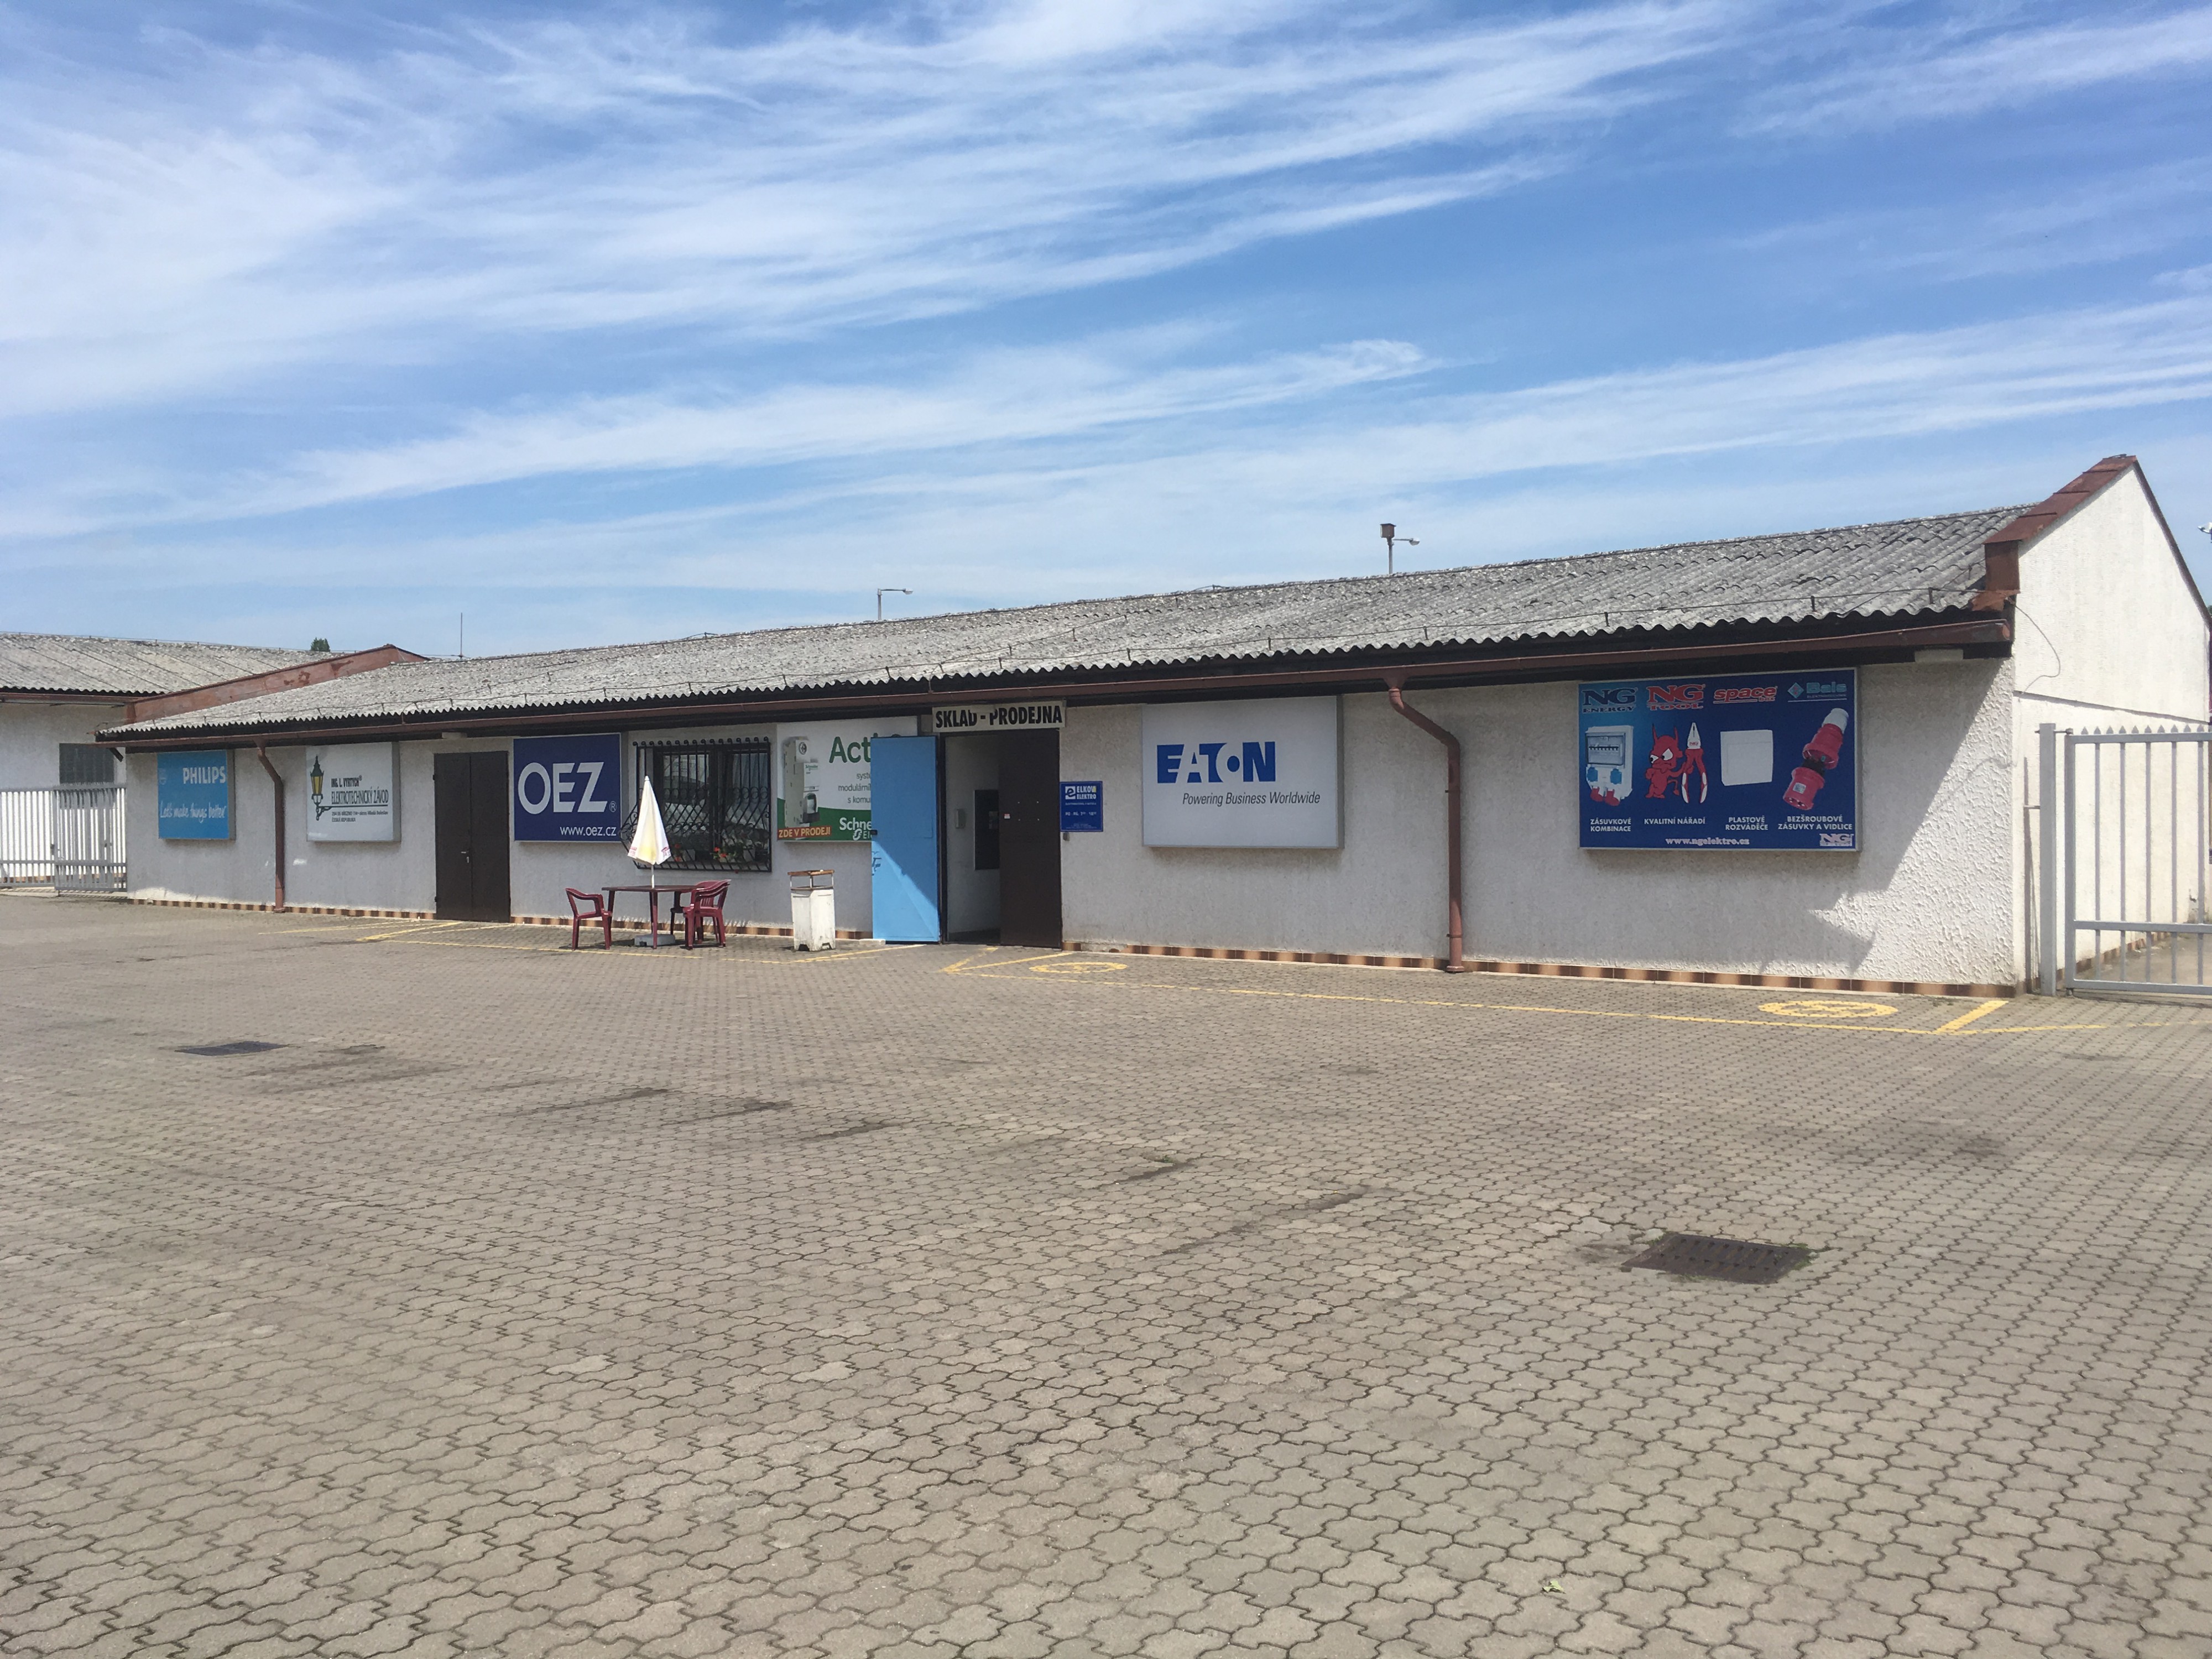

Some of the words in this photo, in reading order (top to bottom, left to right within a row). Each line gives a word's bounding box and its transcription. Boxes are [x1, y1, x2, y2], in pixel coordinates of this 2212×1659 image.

[1646, 684, 1705, 703] NG
[1714, 686, 1777, 702] space
[1807, 681, 1847, 693] Bals
[1582, 688, 1636, 706] NG
[1583, 705, 1636, 713] ENERGY
[1647, 703, 1704, 711] TOOL
[936, 709, 978, 728] SKLAD
[989, 705, 1063, 726] PRODEJNA
[829, 733, 878, 764] Act
[1156, 741, 1276, 784] EATON
[182, 766, 226, 784] PHILIPS
[331, 786, 373, 805] ELEKTROTECHNICKÝ
[373, 786, 389, 804] ZÁVOD
[518, 761, 608, 815] OEZ
[1182, 792, 1223, 807] Powering
[1225, 792, 1266, 805] Business
[1269, 791, 1321, 804] Worldwide
[173, 803, 189, 818] make
[208, 801, 227, 818] better
[1590, 817, 1631, 825] ZÁSUVKOVÉ
[1644, 816, 1676, 825] KVALITNÍ
[1677, 816, 1706, 825] NÁŘADÍ
[1728, 815, 1765, 823] PLASTOVÉ
[1787, 815, 1843, 823] BEZŠROUBOVÉ
[560, 826, 617, 837] www.oez.cz
[779, 829, 793, 838] ZDE
[794, 828, 800, 837] V
[1665, 837, 1750, 847] www.ngelektro.cz
